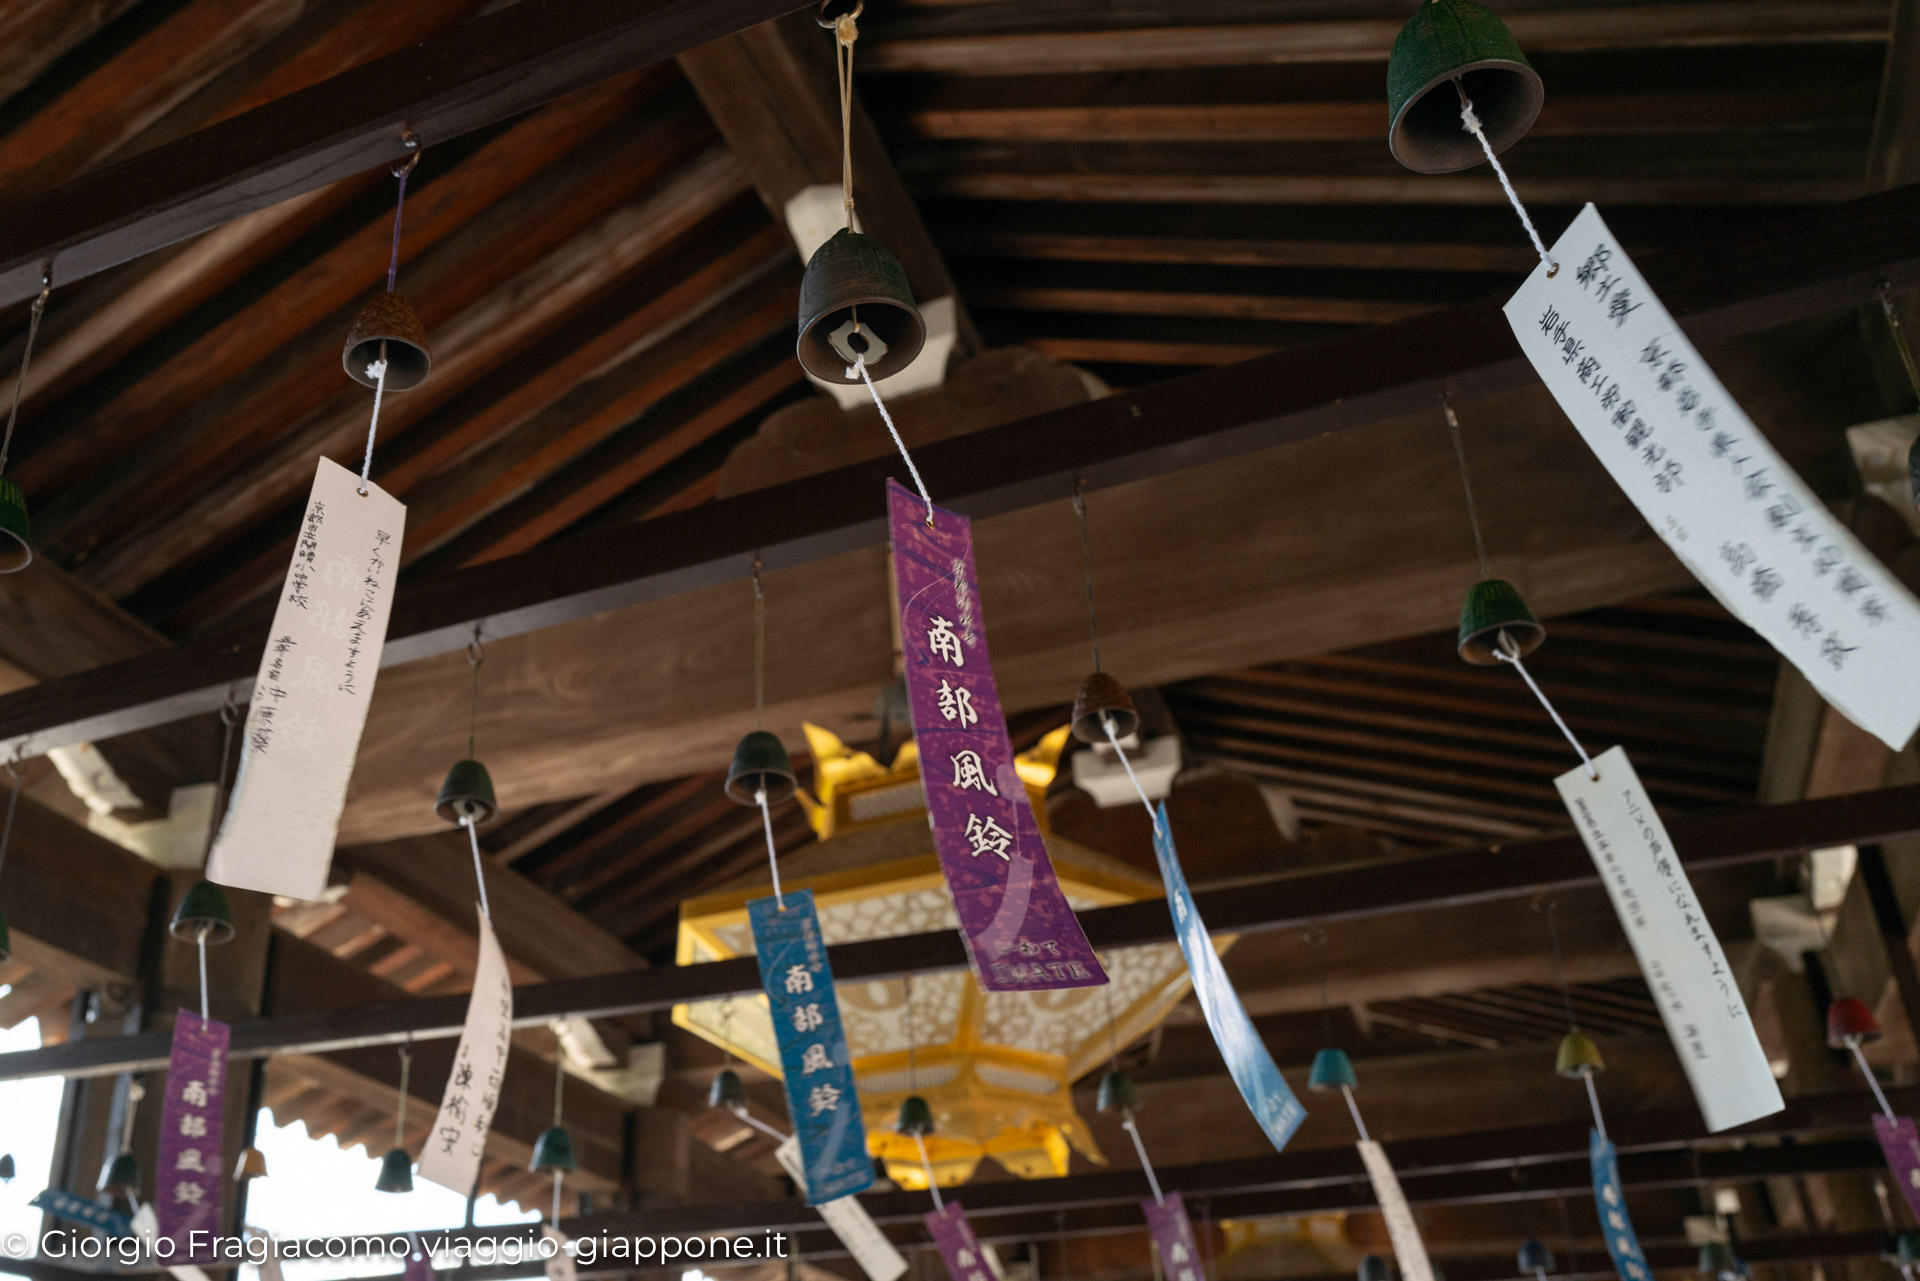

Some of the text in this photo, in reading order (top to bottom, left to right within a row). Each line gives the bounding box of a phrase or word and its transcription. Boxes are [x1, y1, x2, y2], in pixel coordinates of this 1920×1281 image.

[928, 615, 1014, 862] 南部風鈴
[1621, 789, 1744, 1019] アニメの声優になれますように
[784, 964, 842, 1116] 南部風鈴
